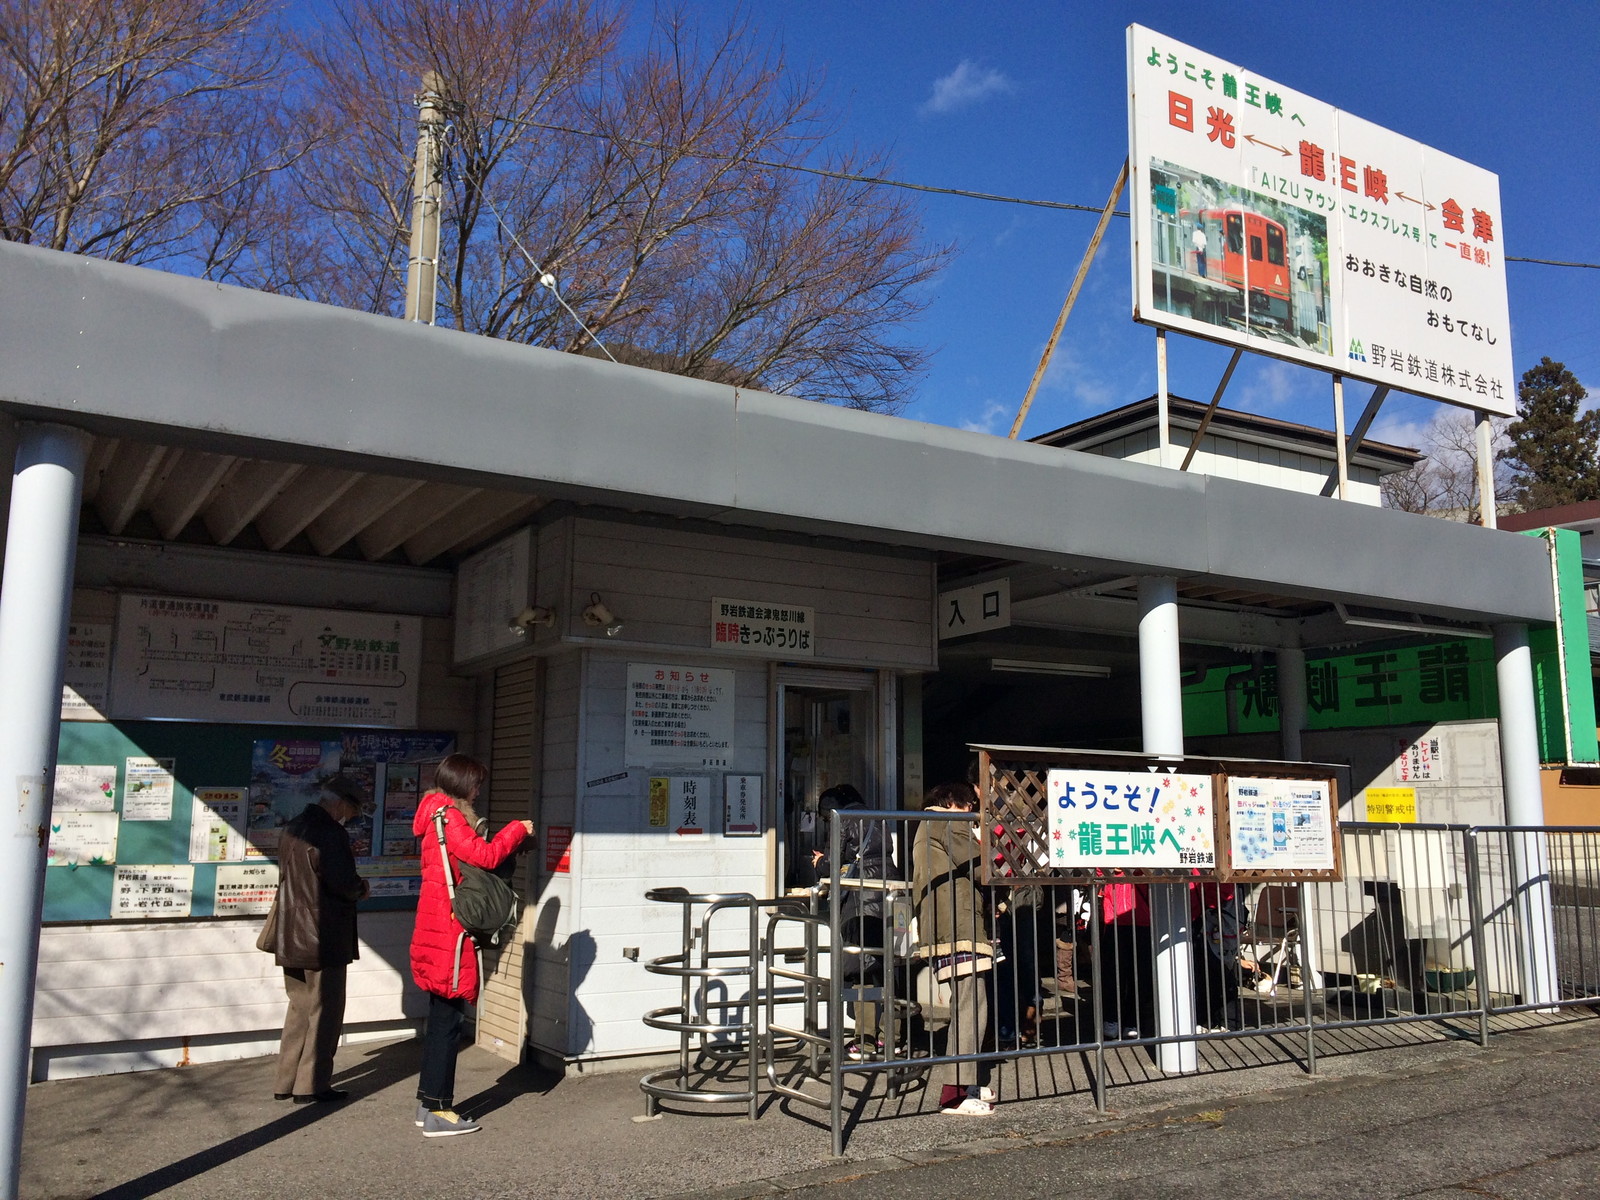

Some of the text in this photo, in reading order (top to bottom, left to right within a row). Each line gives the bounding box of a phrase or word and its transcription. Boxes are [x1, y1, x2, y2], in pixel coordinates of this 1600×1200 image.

[1168, 90, 1495, 244] 日光 龍王峡 会津
[1346, 253, 1453, 302] おおきな自然の
[1427, 309, 1497, 346] おもてなし
[1371, 343, 1505, 401] 野岩鉄道株式会社
[720, 604, 805, 624] 野岩鉄道会津鬼怒川線
[948, 591, 999, 627] 入口
[335, 637, 401, 654] 野岩鉄道
[715, 622, 810, 649] 臨時きっぷうりば
[654, 670, 710, 683] お知らせ
[268, 744, 293, 769] 冬
[1411, 744, 1420, 779] ありません
[1430, 737, 1439, 761] 当駅に
[683, 780, 697, 826] 時刻表
[1058, 781, 1160, 814] ようこそ!
[1366, 804, 1415, 815] 特別警戒中
[1078, 821, 1181, 856] 龍王峡へ
[1179, 852, 1214, 864] 野岩鉄道
